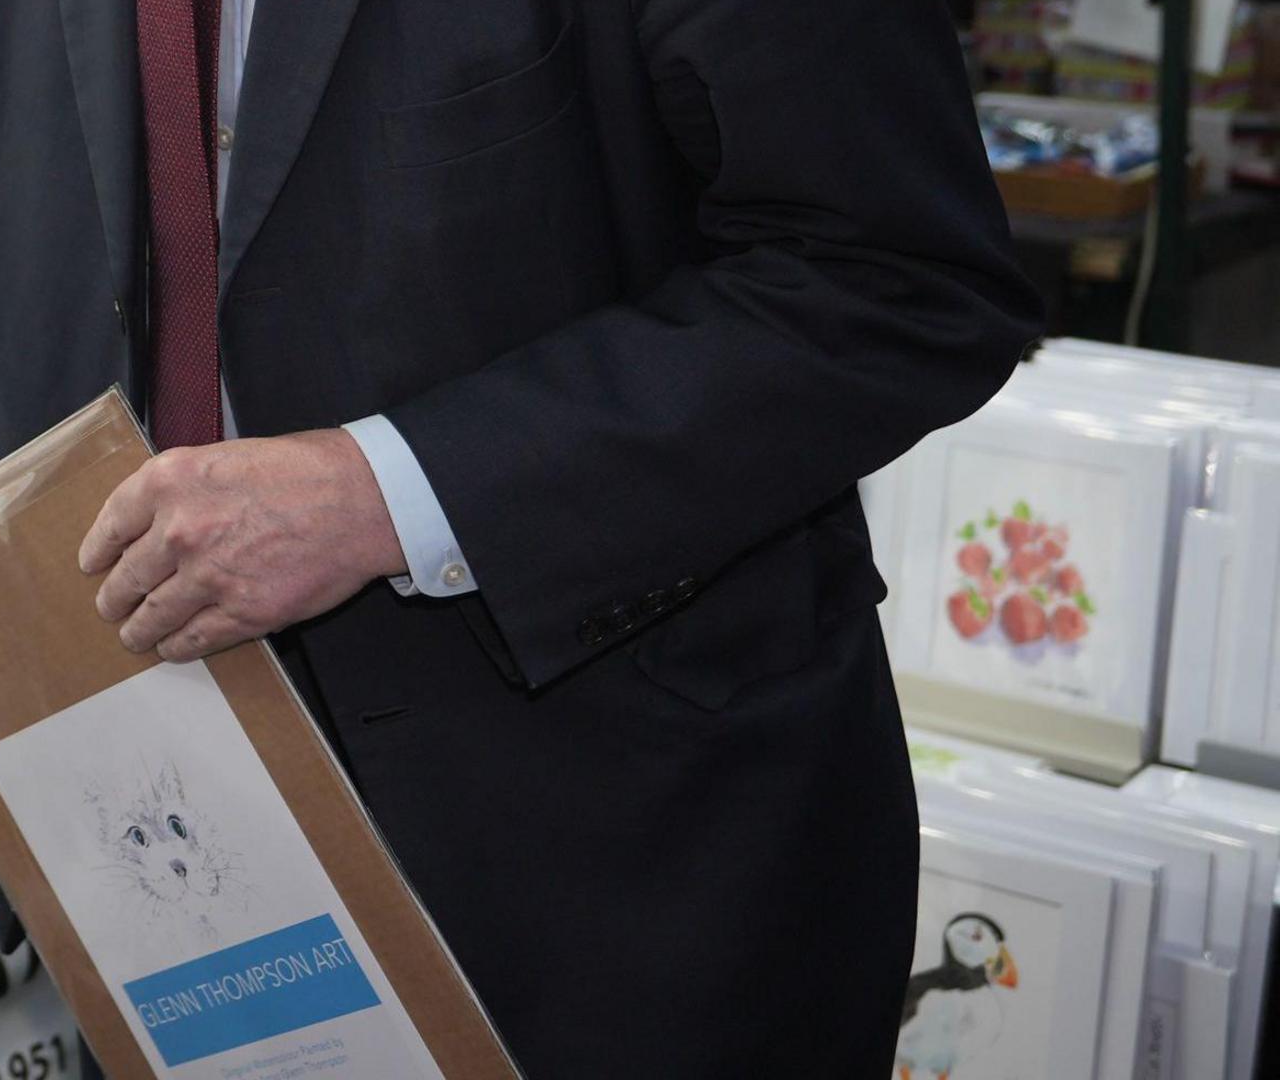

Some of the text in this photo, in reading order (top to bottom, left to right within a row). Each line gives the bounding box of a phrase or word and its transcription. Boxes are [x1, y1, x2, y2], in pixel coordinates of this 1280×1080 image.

[137, 938, 352, 1027] GLENN THOMPSON ART
[8, 1033, 66, 1080] 951
